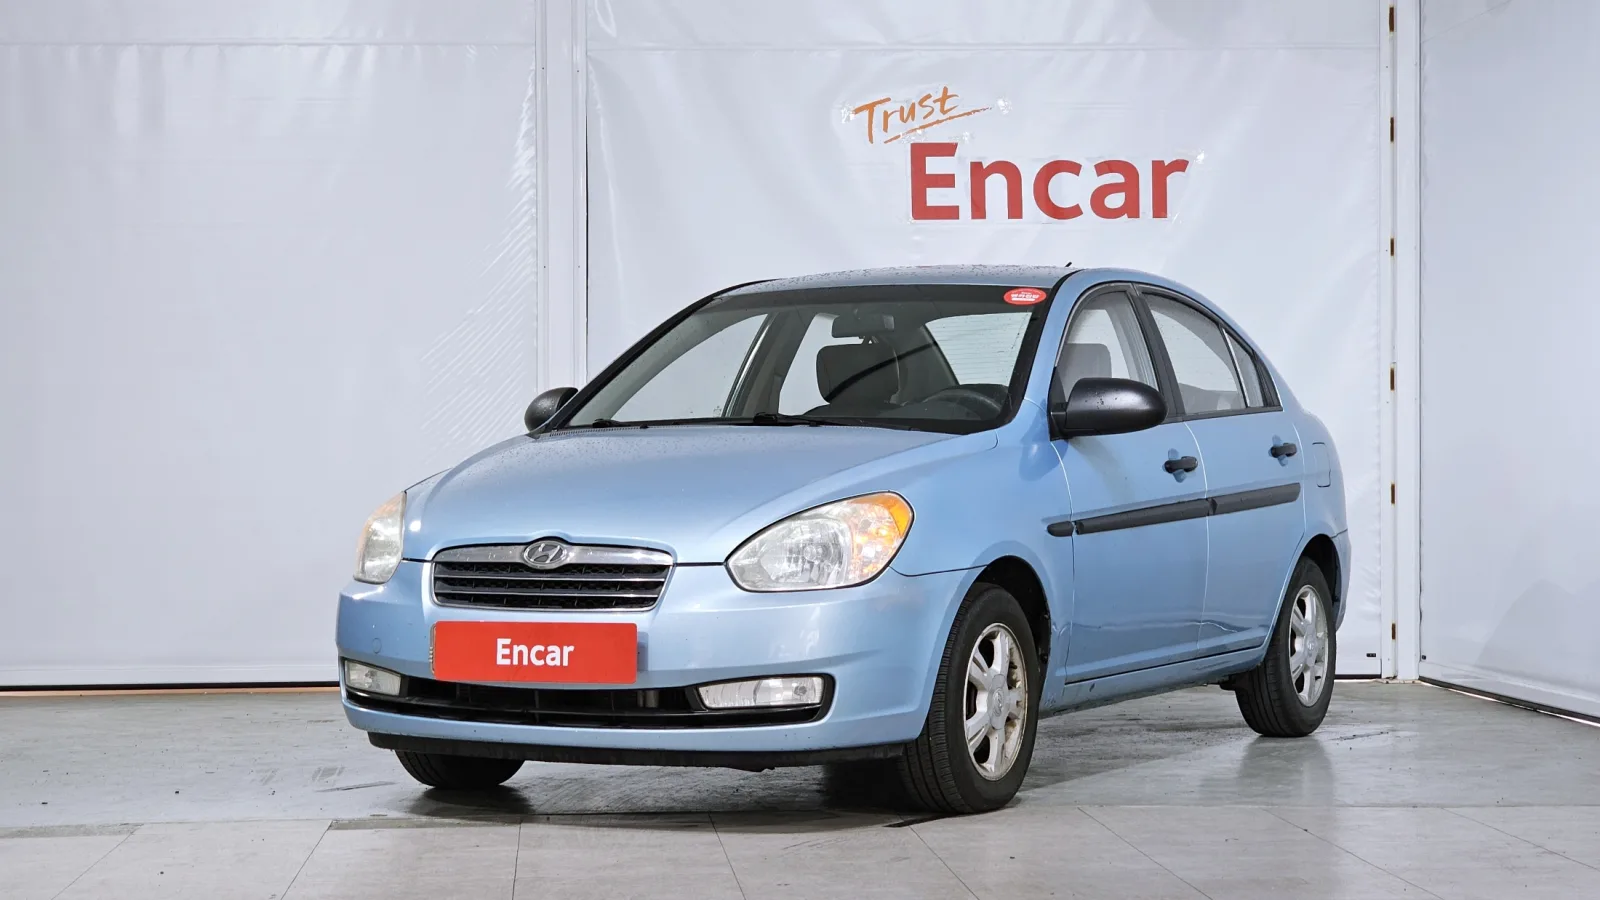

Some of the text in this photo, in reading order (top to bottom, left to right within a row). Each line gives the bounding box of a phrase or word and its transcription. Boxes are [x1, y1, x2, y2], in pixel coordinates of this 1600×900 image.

[853, 86, 960, 144] Trust
[910, 142, 1189, 220] Encar
[496, 638, 575, 667] Encar
